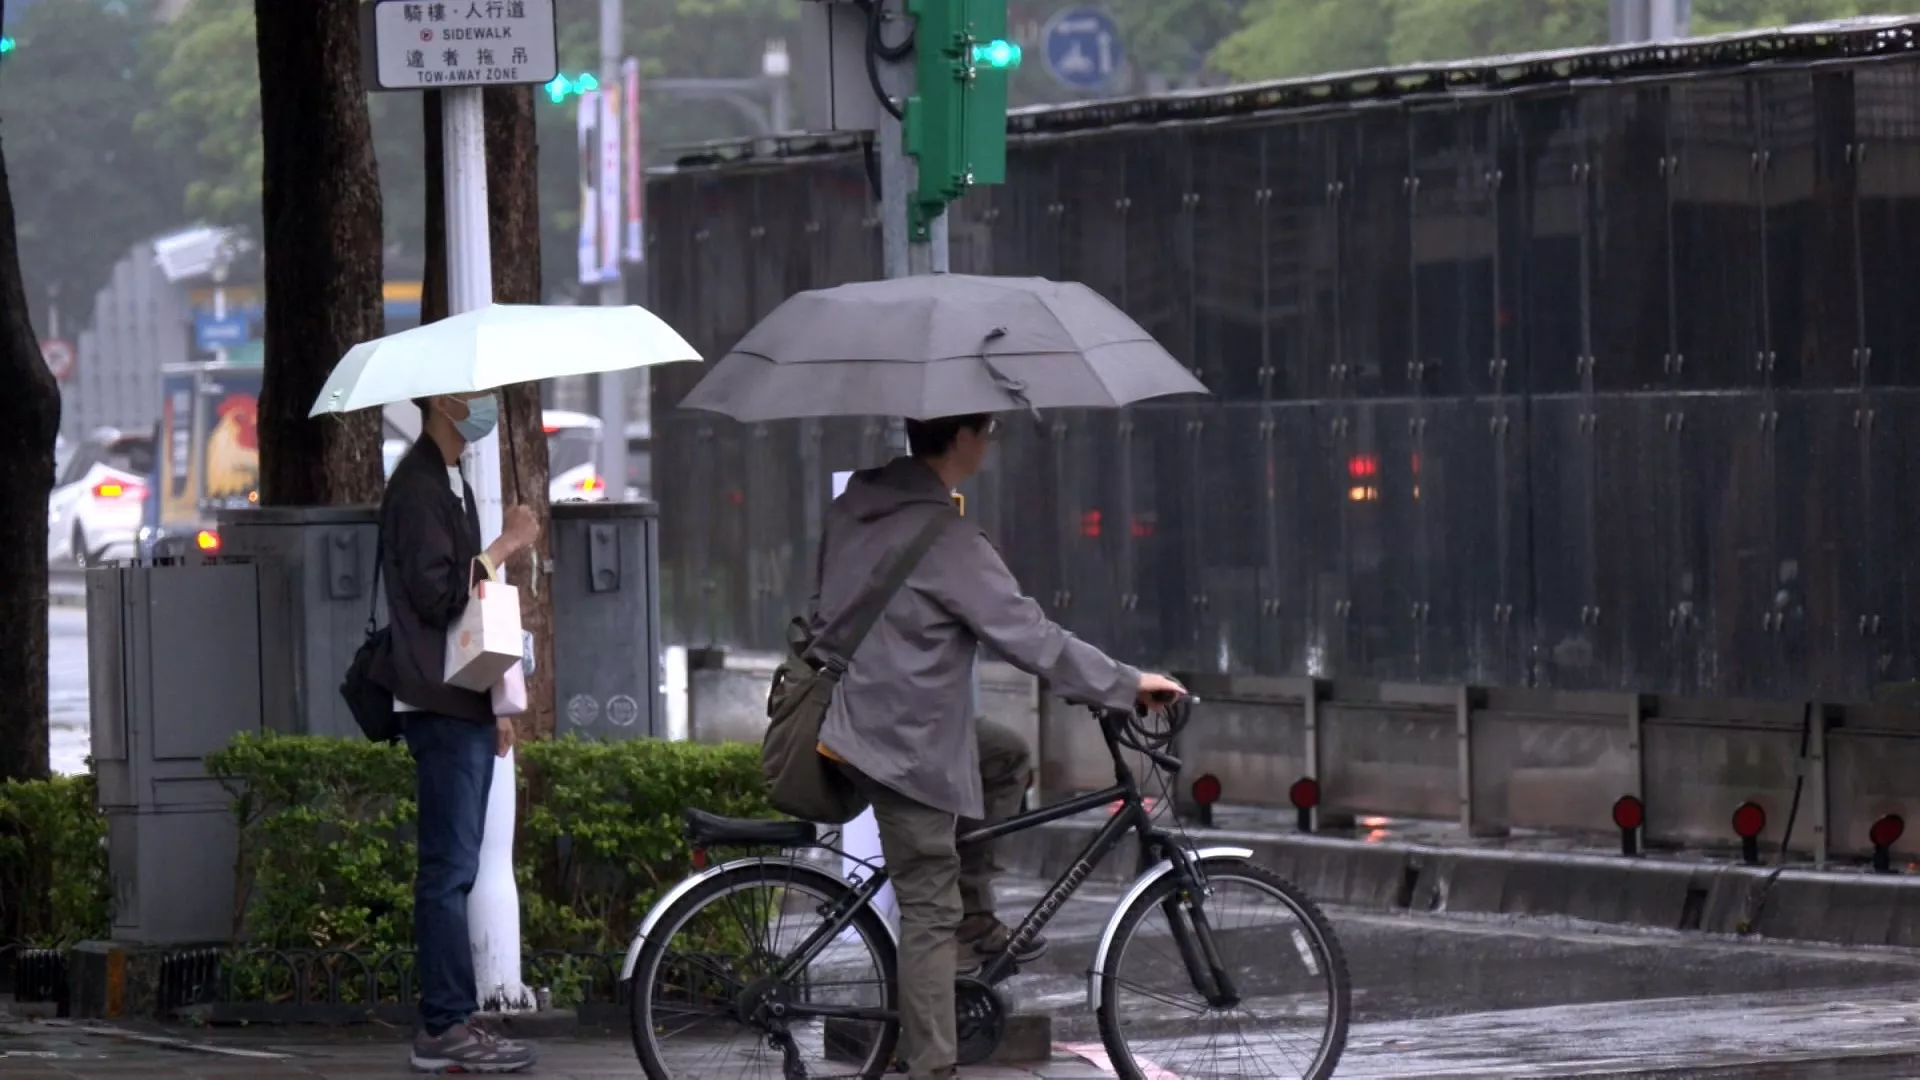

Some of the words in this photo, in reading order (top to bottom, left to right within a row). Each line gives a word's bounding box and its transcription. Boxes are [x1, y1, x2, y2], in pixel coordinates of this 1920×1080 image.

[442, 27, 512, 41] SIDEWALK
[417, 70, 481, 83] TOW-AWAY
[486, 68, 518, 80] ZONE
